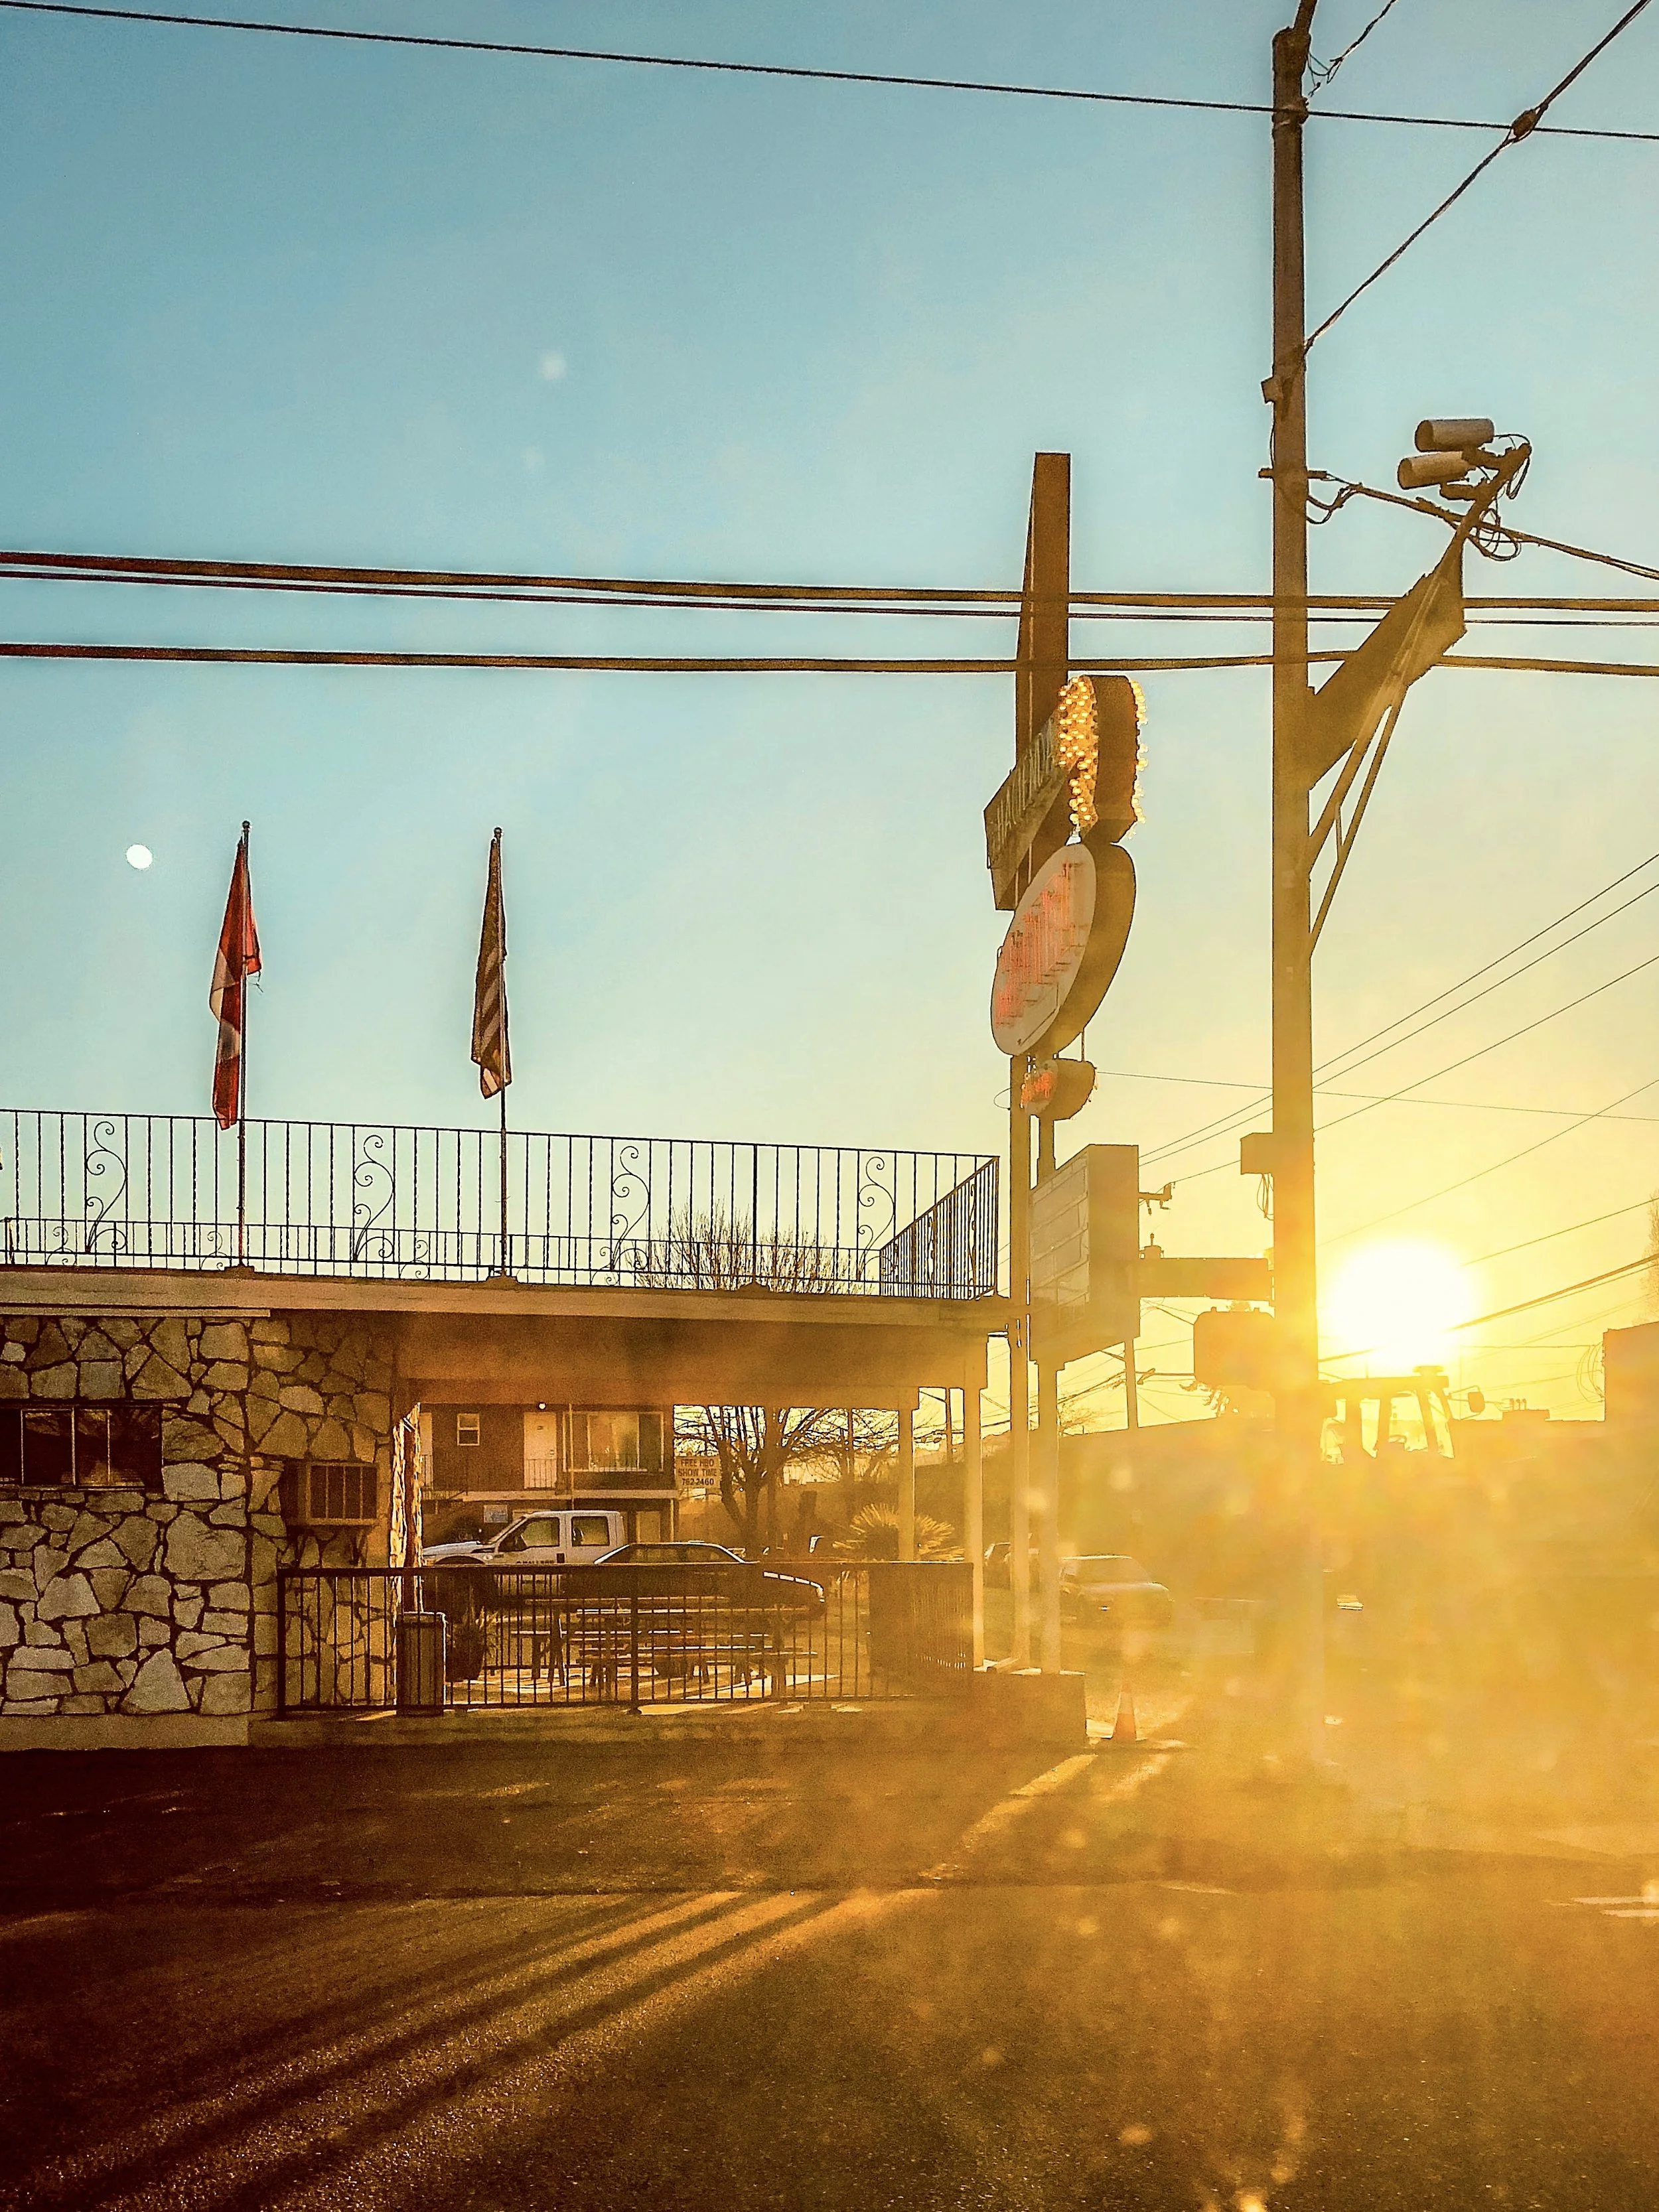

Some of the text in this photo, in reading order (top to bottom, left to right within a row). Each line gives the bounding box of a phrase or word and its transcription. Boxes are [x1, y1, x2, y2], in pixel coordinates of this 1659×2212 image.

[681, 1458, 715, 1467] FREE HBO
[678, 1468, 717, 1477] SHOW TIME
